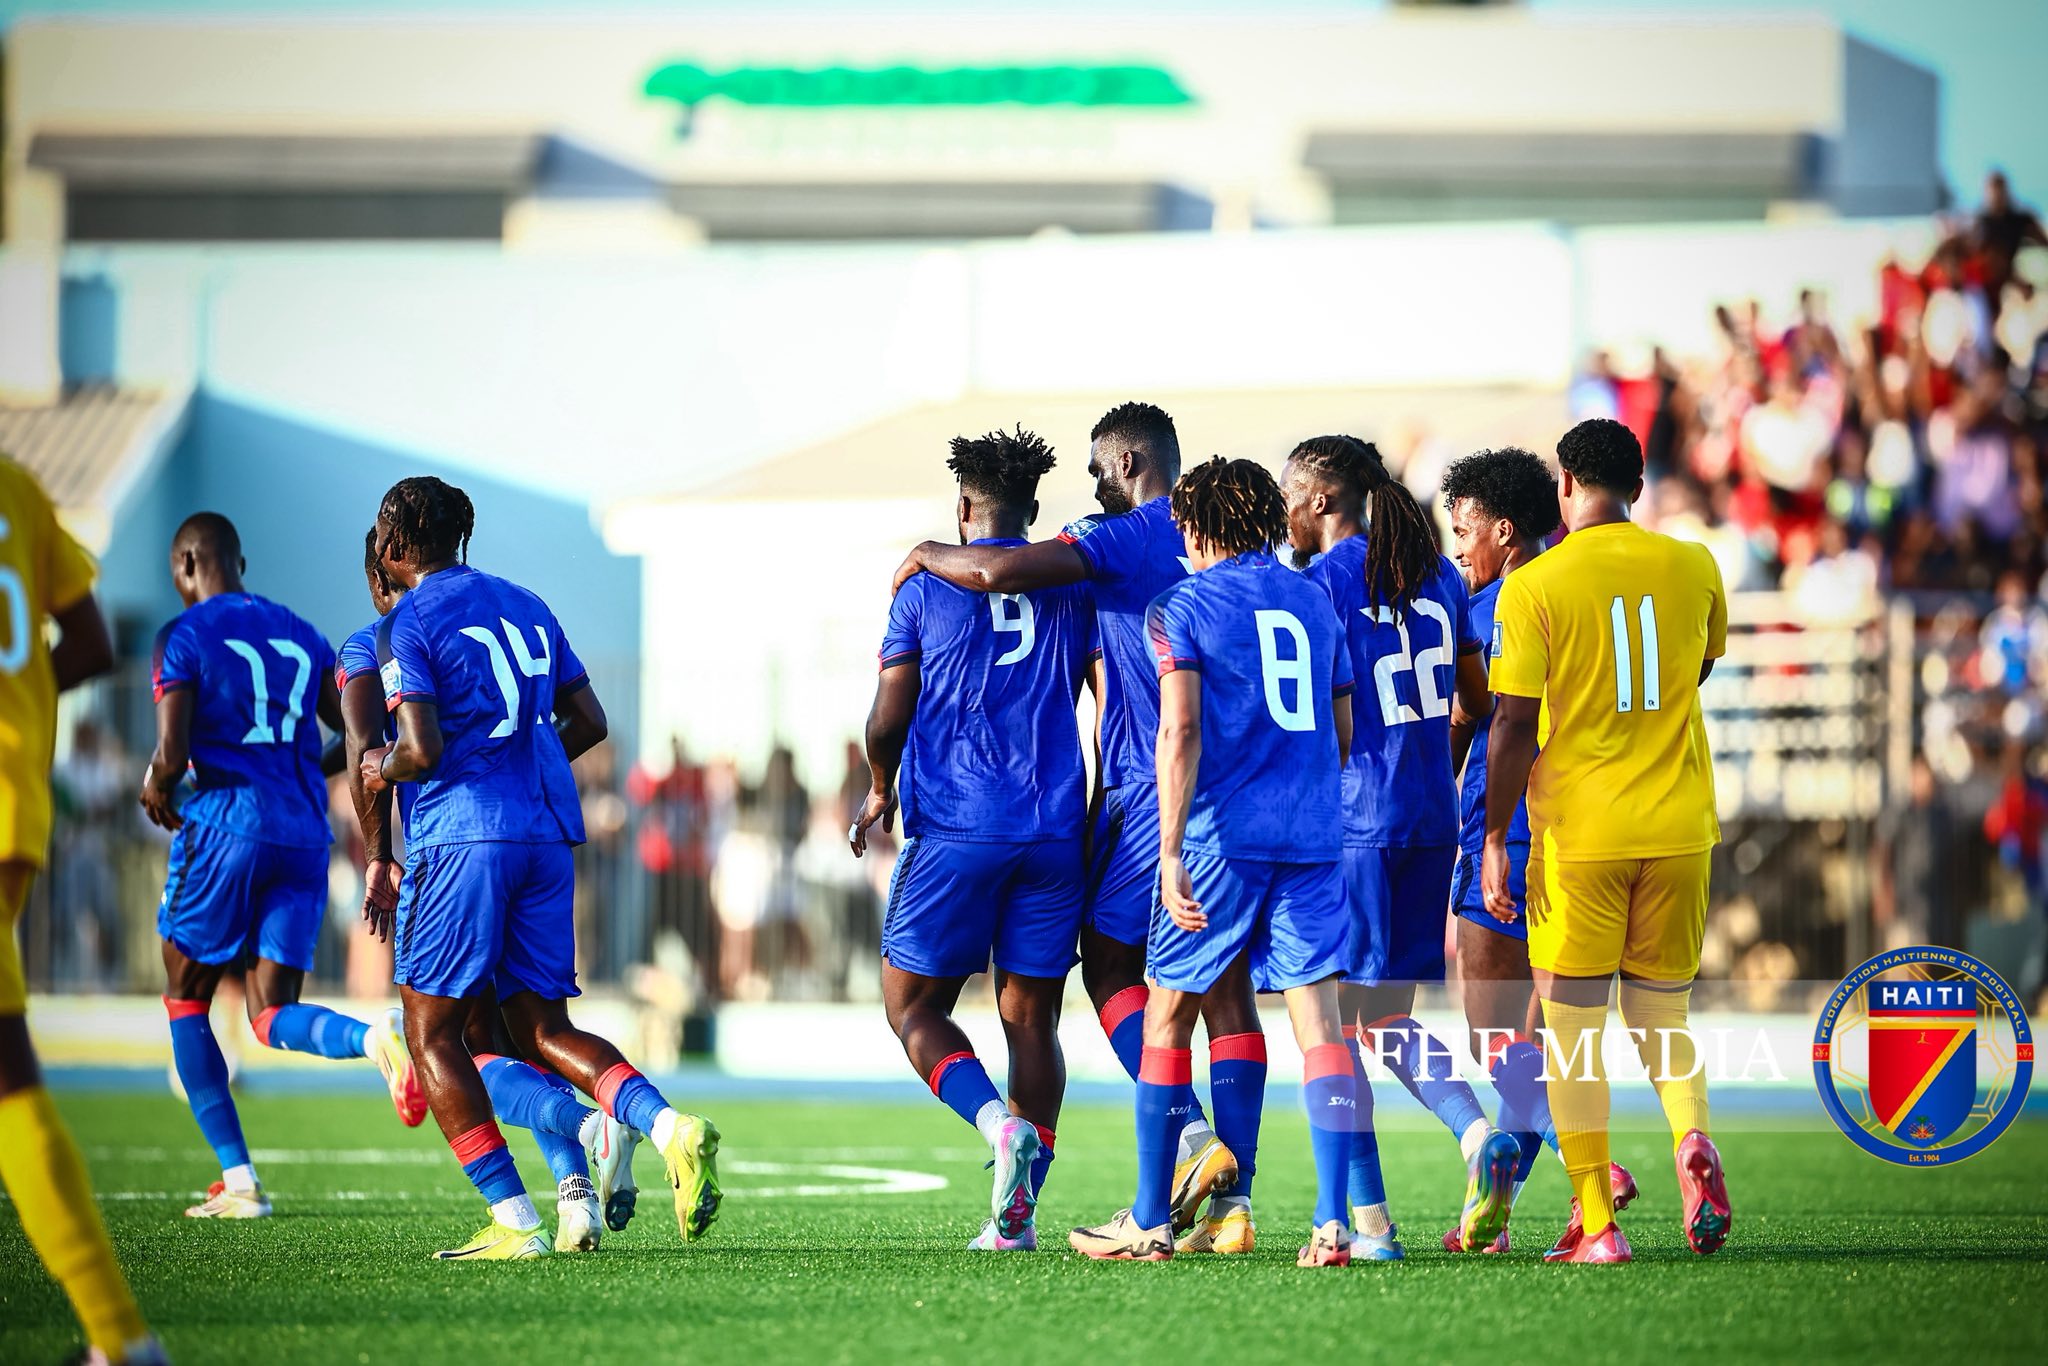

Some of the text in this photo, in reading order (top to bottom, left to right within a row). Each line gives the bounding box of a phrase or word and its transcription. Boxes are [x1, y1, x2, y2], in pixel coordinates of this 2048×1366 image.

[458, 616, 557, 739] 14
[988, 592, 1036, 666] 9
[1254, 609, 1317, 731] 8
[1359, 598, 1454, 727] 22
[1610, 594, 1660, 713] 11
[224, 638, 311, 744] 17
